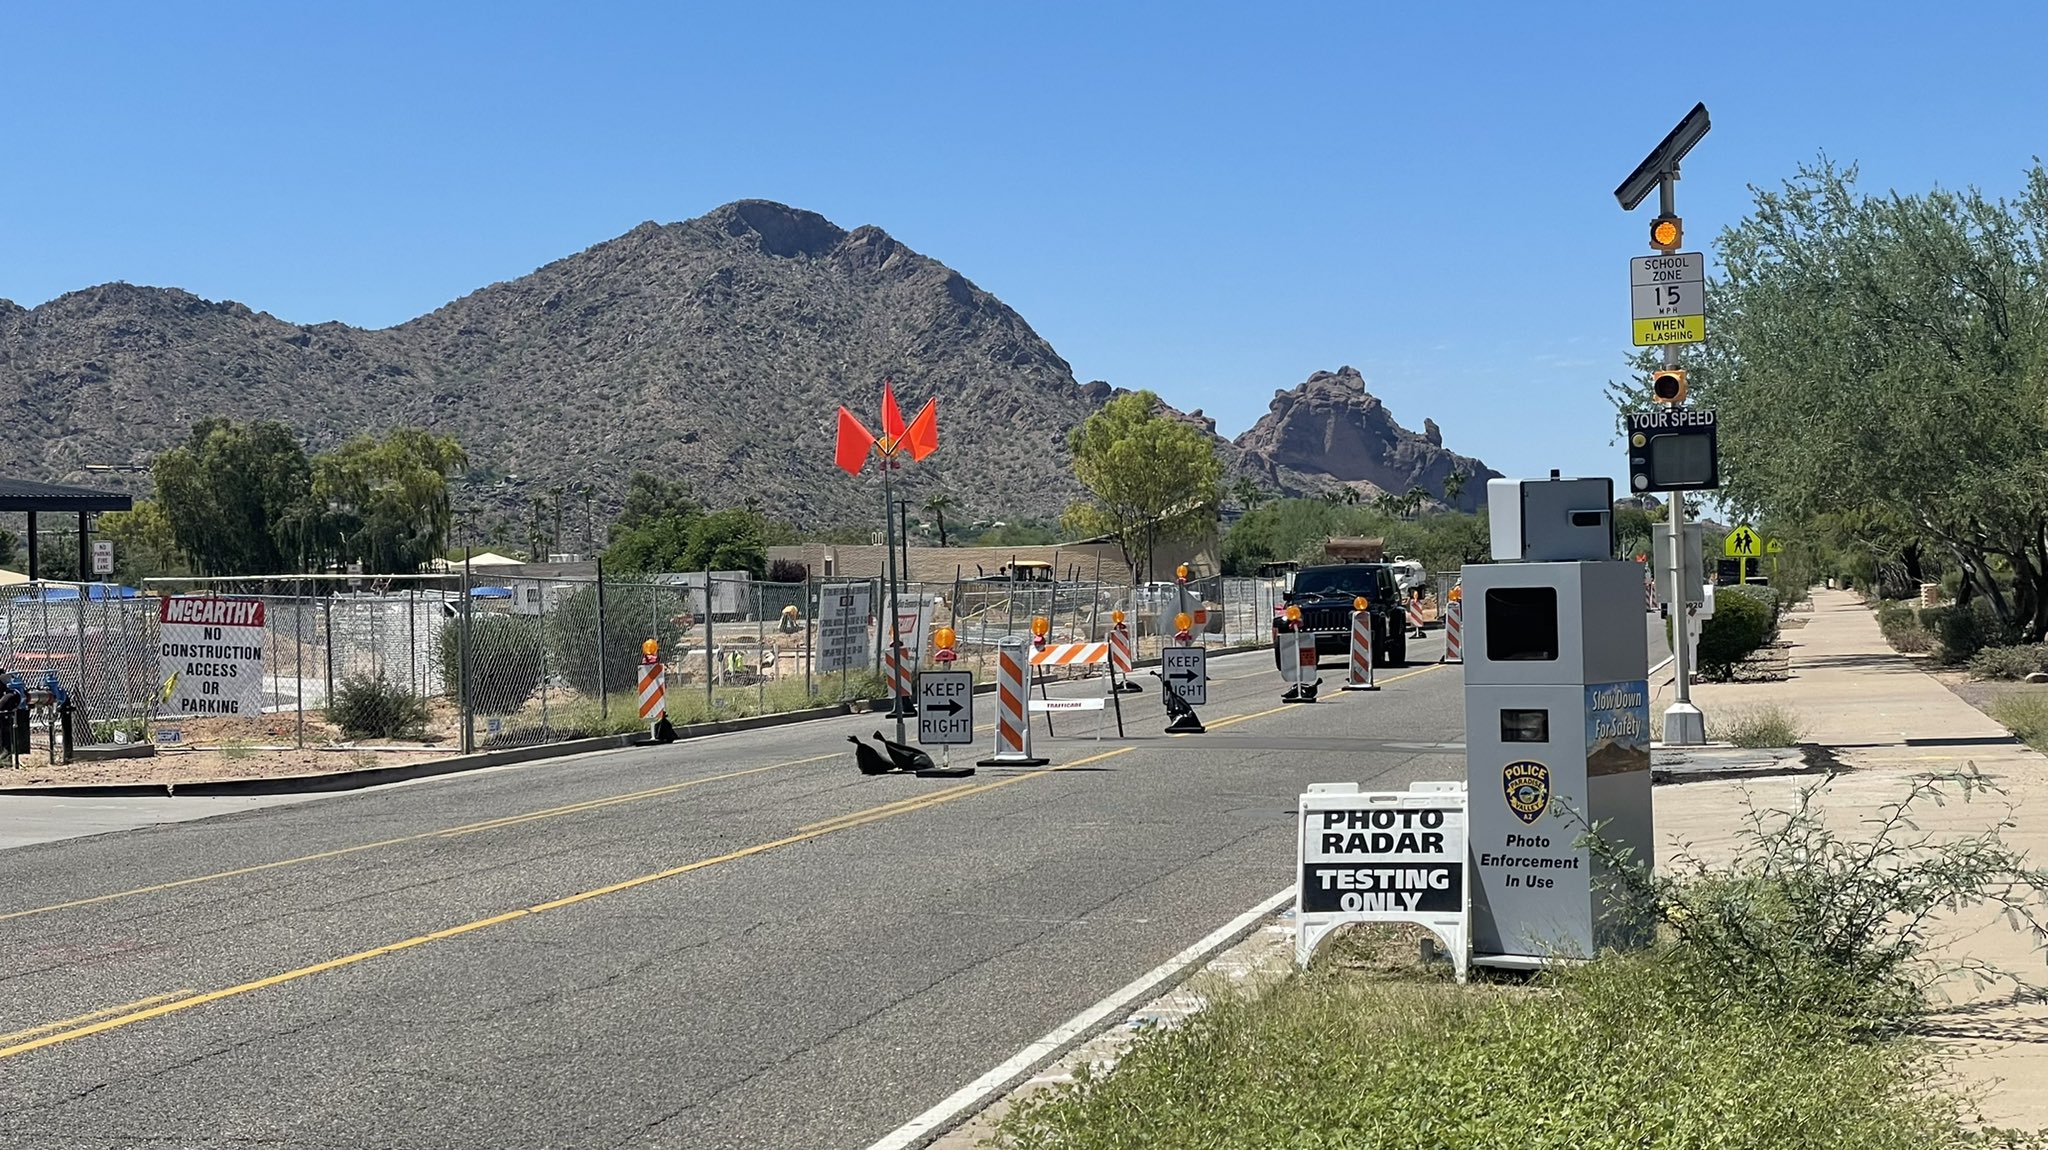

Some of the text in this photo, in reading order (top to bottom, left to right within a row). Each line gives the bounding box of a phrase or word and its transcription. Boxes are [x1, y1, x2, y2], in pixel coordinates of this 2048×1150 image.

[1644, 257, 1689, 270] SCHOOL
[1652, 269, 1682, 281] ZONE
[1655, 286, 1681, 306] 15
[1658, 306, 1678, 315] MPH
[1652, 319, 1685, 331] WHEN
[1645, 330, 1693, 342] FLASHING
[1631, 411, 1714, 429] YOUR SPEED
[203, 627, 221, 641] NO
[162, 643, 262, 661] CONSTRUCTION
[1168, 656, 1200, 668] KEEP
[186, 662, 237, 678] ACCESS
[202, 681, 219, 695] OR
[925, 682, 966, 697] KEEP
[181, 698, 239, 714] PARKING
[1592, 689, 1642, 711] Slow Down
[922, 719, 969, 733] RIGHT
[1595, 716, 1641, 740] For Safety
[1505, 764, 1547, 780] POLICE
[1510, 778, 1543, 789] PARADISE
[1515, 803, 1541, 812] VALLEY
[1323, 809, 1444, 830] PHOTO
[1321, 832, 1444, 854] RADAR
[1506, 834, 1550, 848] Photo
[1480, 853, 1579, 869] Enforcement
[1316, 869, 1450, 890] TESTING
[1505, 874, 1554, 888] In Use
[1340, 892, 1423, 912] ONLY
